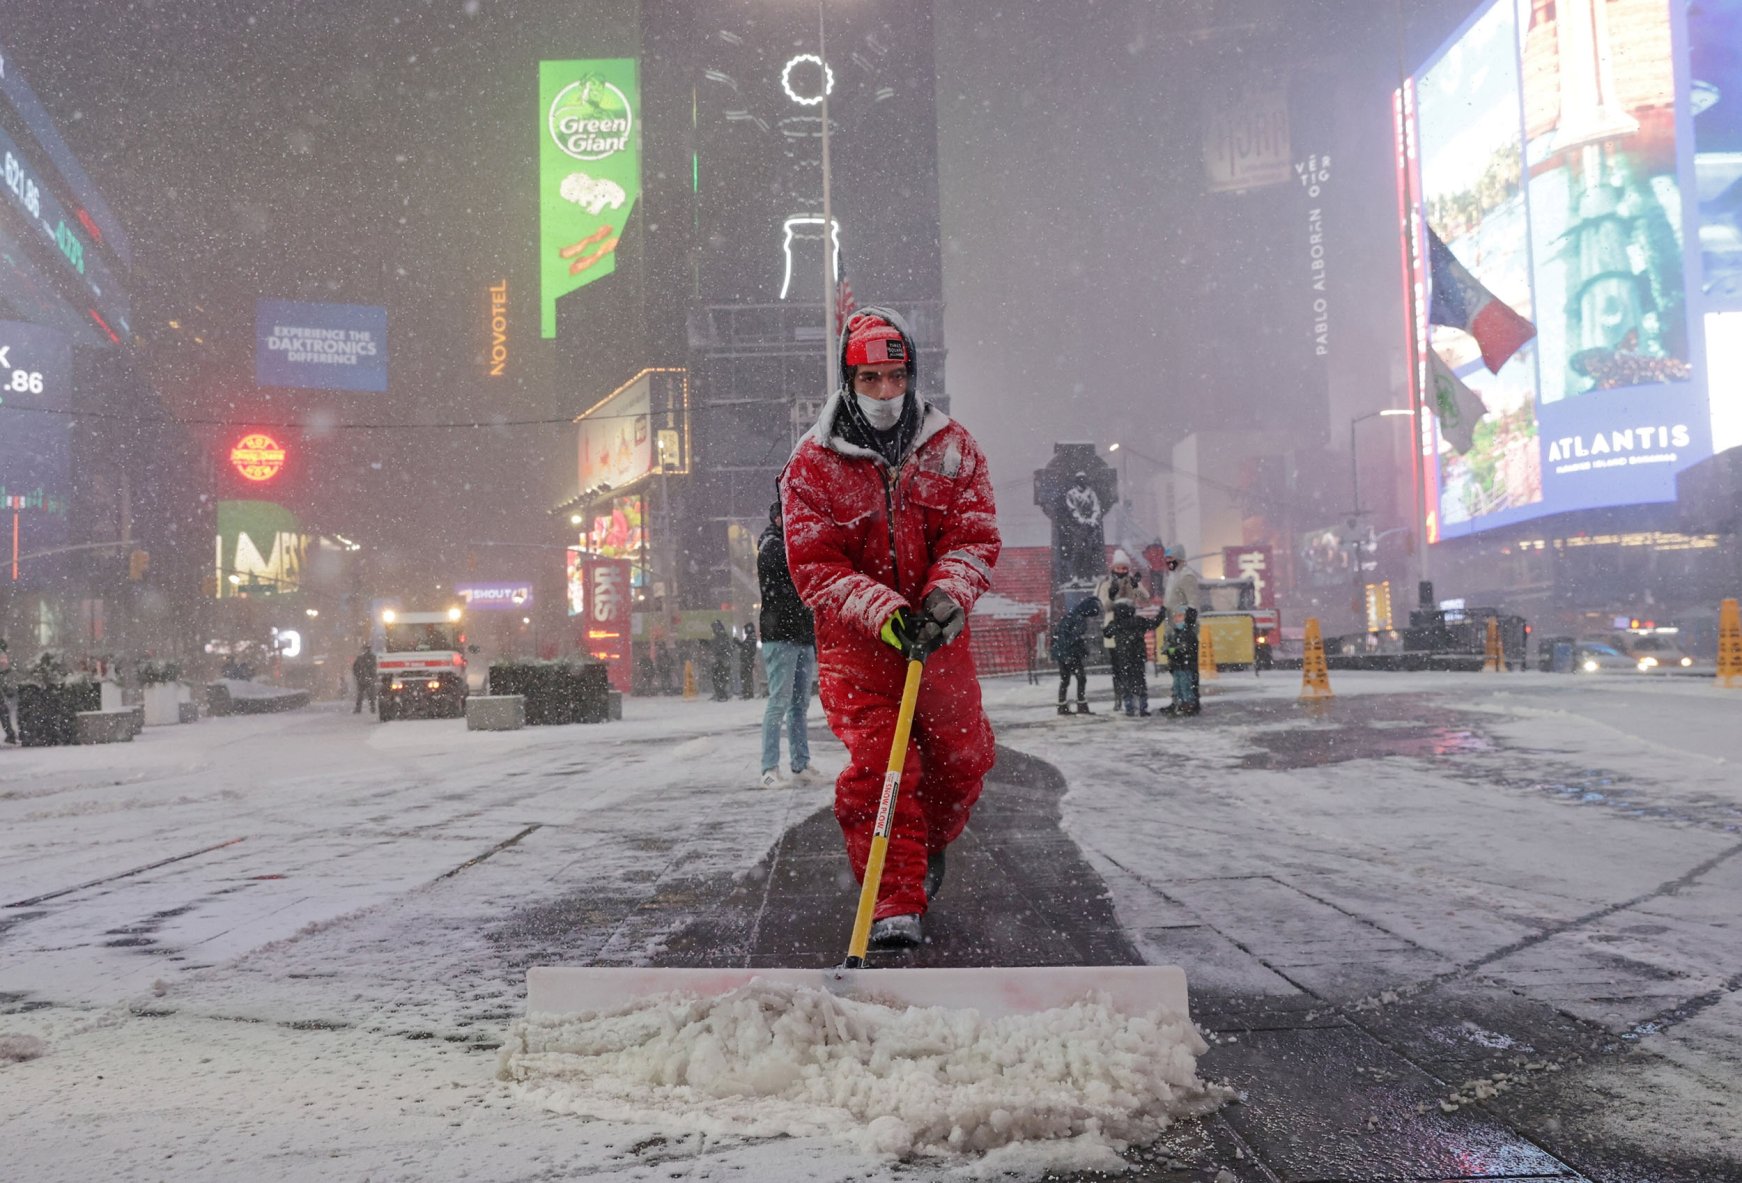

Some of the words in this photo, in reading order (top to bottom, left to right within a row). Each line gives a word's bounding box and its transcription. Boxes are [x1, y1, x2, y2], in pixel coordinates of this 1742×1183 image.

[560, 116, 626, 134] Green
[567, 133, 628, 153] Giant
[273, 325, 346, 341] EXPERIENCE
[348, 330, 370, 341] THE
[490, 279, 506, 376] NOVOTEL
[1313, 298, 1329, 355] PABLO
[267, 336, 377, 355] DAKTRONICS
[288, 351, 357, 364] DIFFERENCE
[1549, 424, 1691, 462] ATLANTIS
[594, 565, 621, 622] tkts
[881, 783, 893, 806] SNOW
